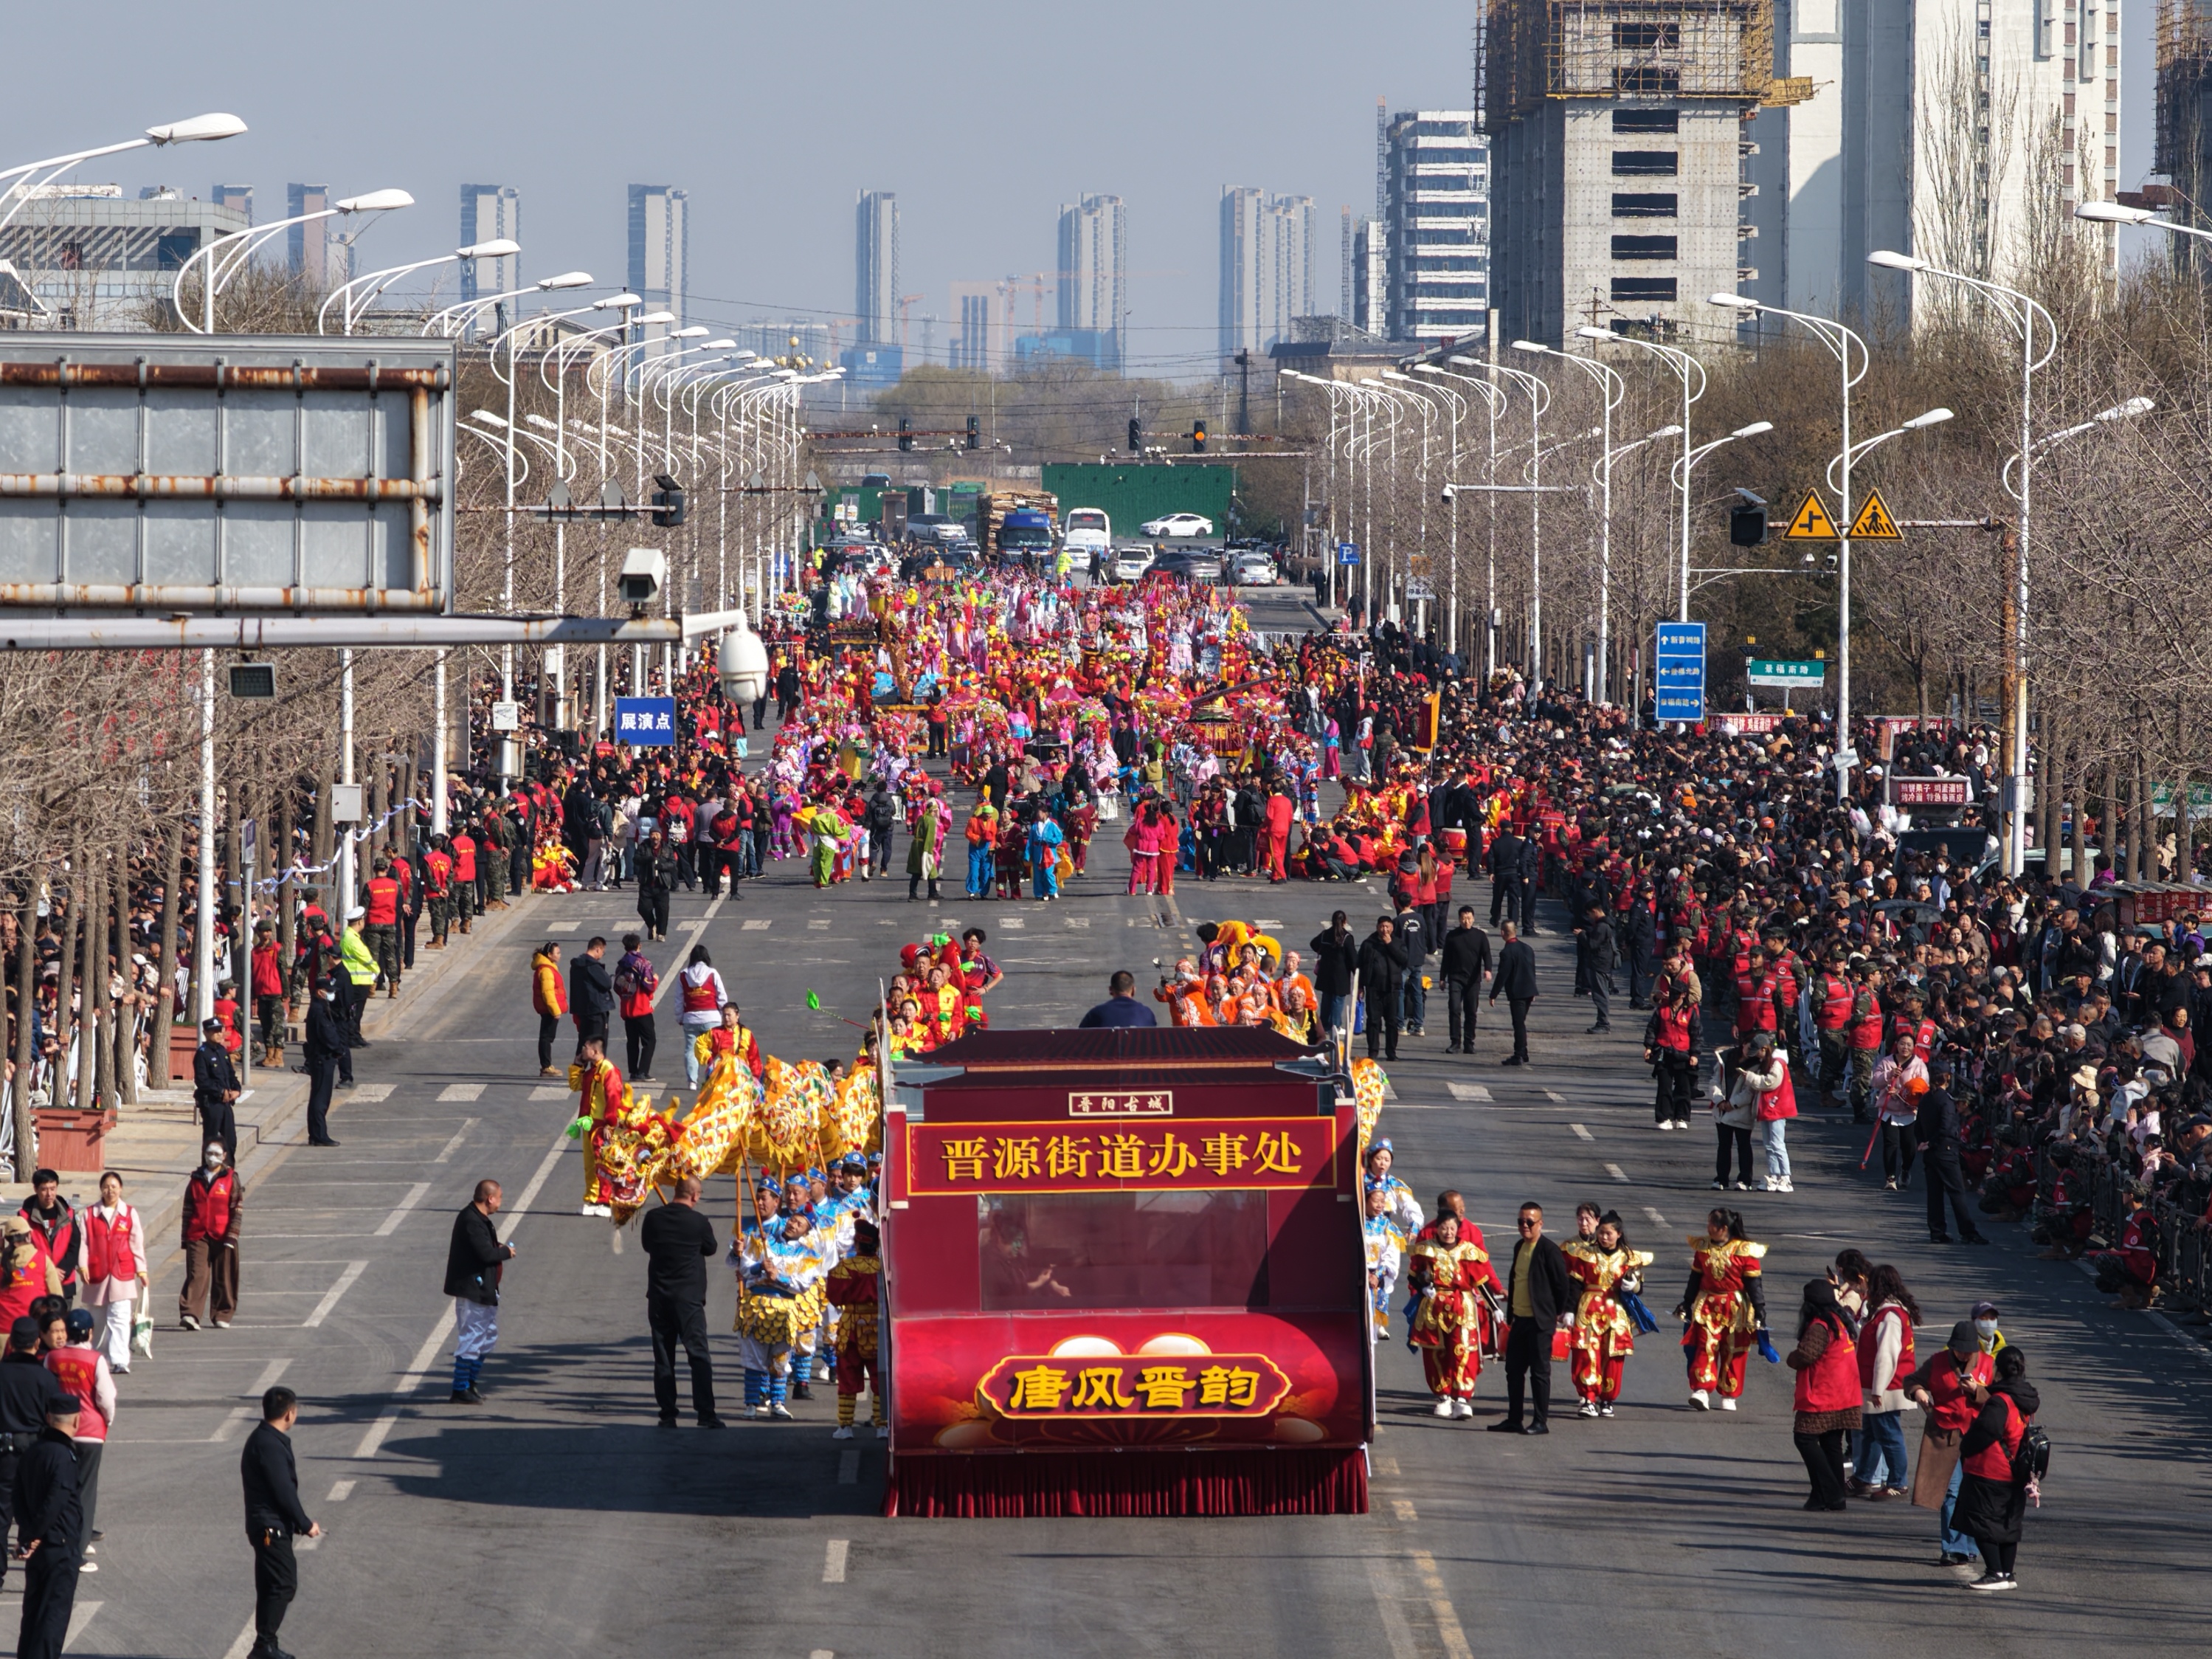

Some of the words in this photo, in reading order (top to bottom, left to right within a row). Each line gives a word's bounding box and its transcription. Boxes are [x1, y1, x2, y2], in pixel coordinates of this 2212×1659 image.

[1341, 546, 1352, 562] P
[1670, 667, 1700, 675] 景福北路
[1765, 663, 1808, 675] 景福南路
[1661, 698, 1690, 706] 景福南路
[621, 712, 671, 731] 展演点
[1078, 1095, 1164, 1112] 晋阳古城
[941, 1131, 1302, 1180] 晋源街道办事处
[1010, 1365, 1260, 1409] 唐风晋韵
